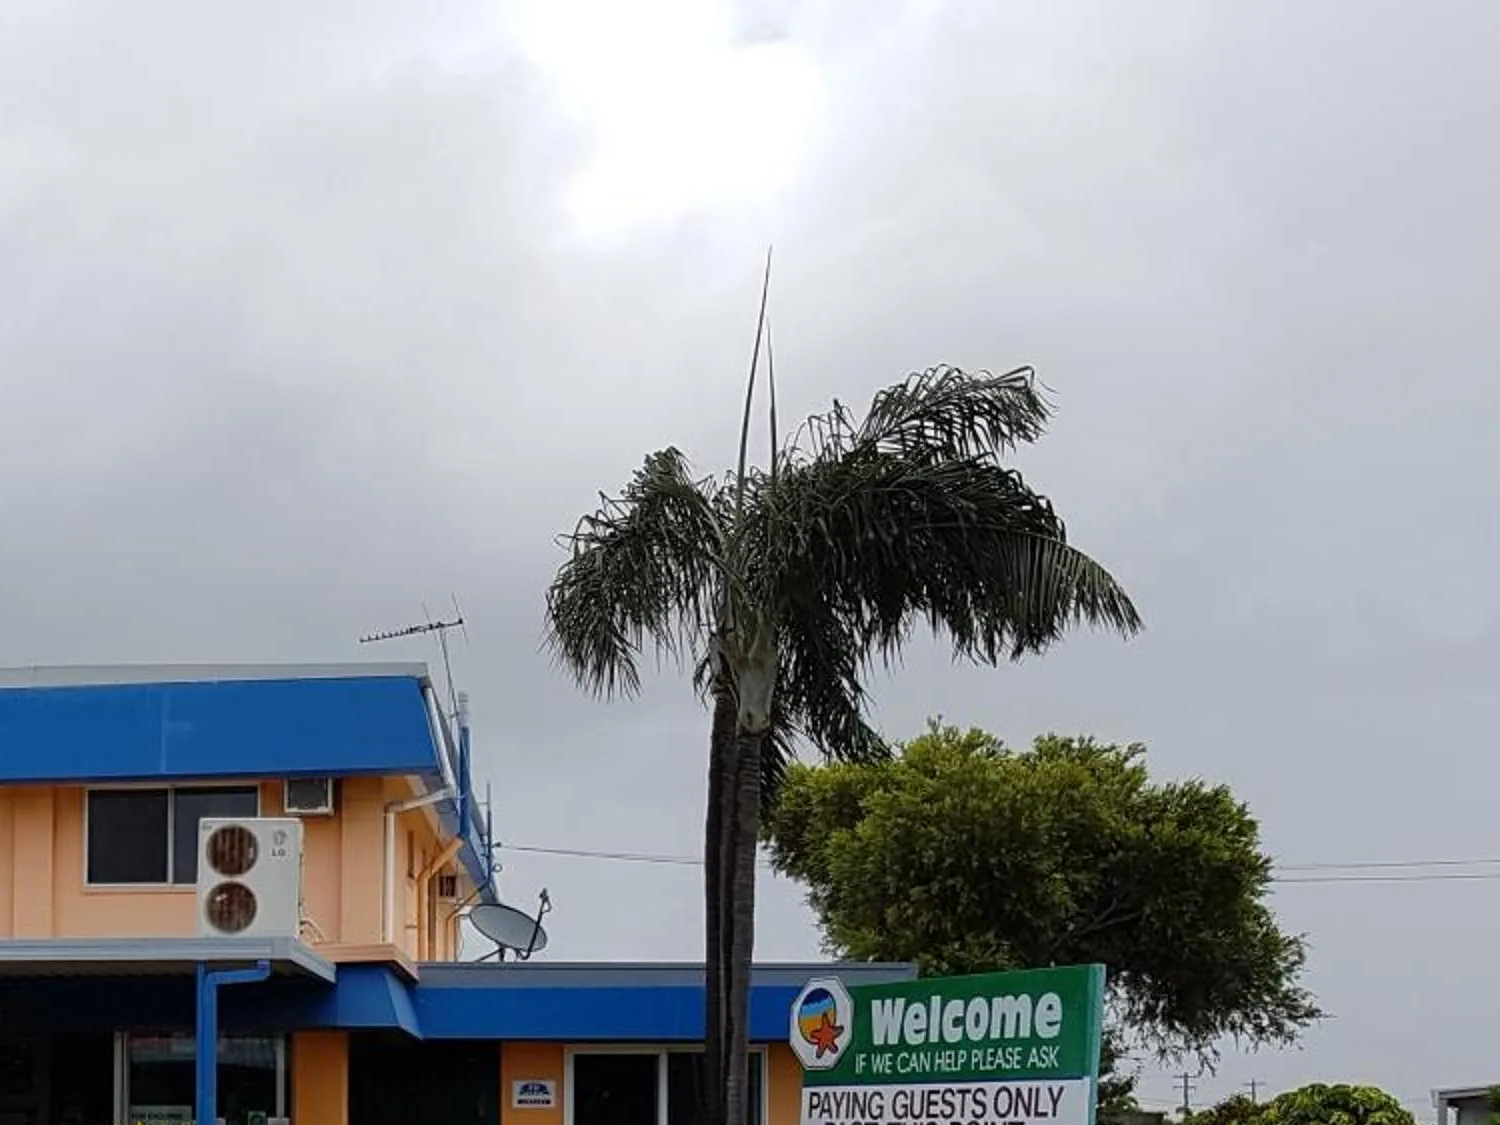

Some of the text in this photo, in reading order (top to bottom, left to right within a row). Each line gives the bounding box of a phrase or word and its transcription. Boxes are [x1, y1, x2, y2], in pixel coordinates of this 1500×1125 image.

[871, 992, 1062, 1045] Welcome
[855, 1046, 1059, 1074] IF WE CAN HELP PLEASE ASK
[808, 1086, 1063, 1119] PAYING GUESTS ONLY
